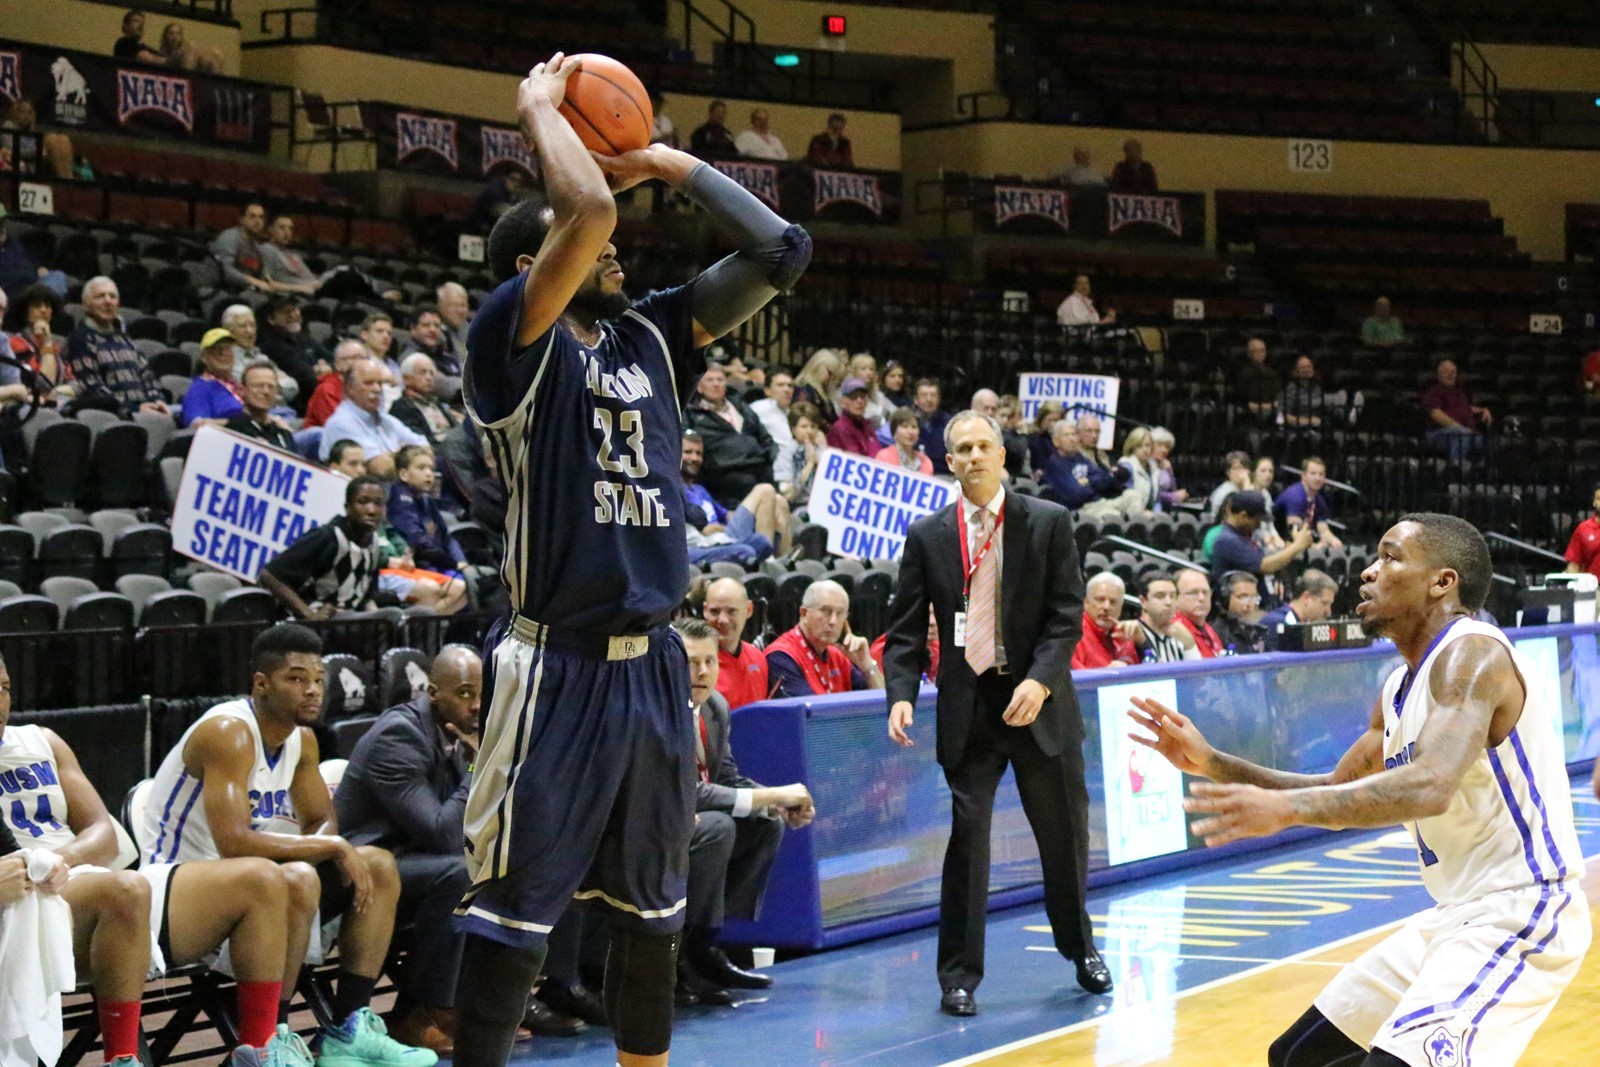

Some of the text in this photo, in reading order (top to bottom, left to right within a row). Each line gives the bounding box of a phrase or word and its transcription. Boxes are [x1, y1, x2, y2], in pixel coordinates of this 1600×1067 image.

[121, 75, 191, 124] NAIA
[401, 118, 456, 161] NAIA
[1292, 142, 1329, 169] 123
[20, 190, 36, 209] 27
[819, 175, 879, 209] NAIA
[1000, 191, 1067, 226] NAIA
[1113, 198, 1178, 233] NAIA
[1028, 377, 1106, 399] VISITING
[594, 408, 649, 478] 23
[227, 443, 312, 506] HOME
[824, 453, 949, 512] RESERVED
[193, 473, 318, 548] TEAM FA
[594, 481, 670, 527] STATE
[826, 489, 925, 537] SEATIN
[190, 519, 278, 576] SEATI
[1311, 624, 1330, 642] POSS
[11, 793, 63, 838] 44
